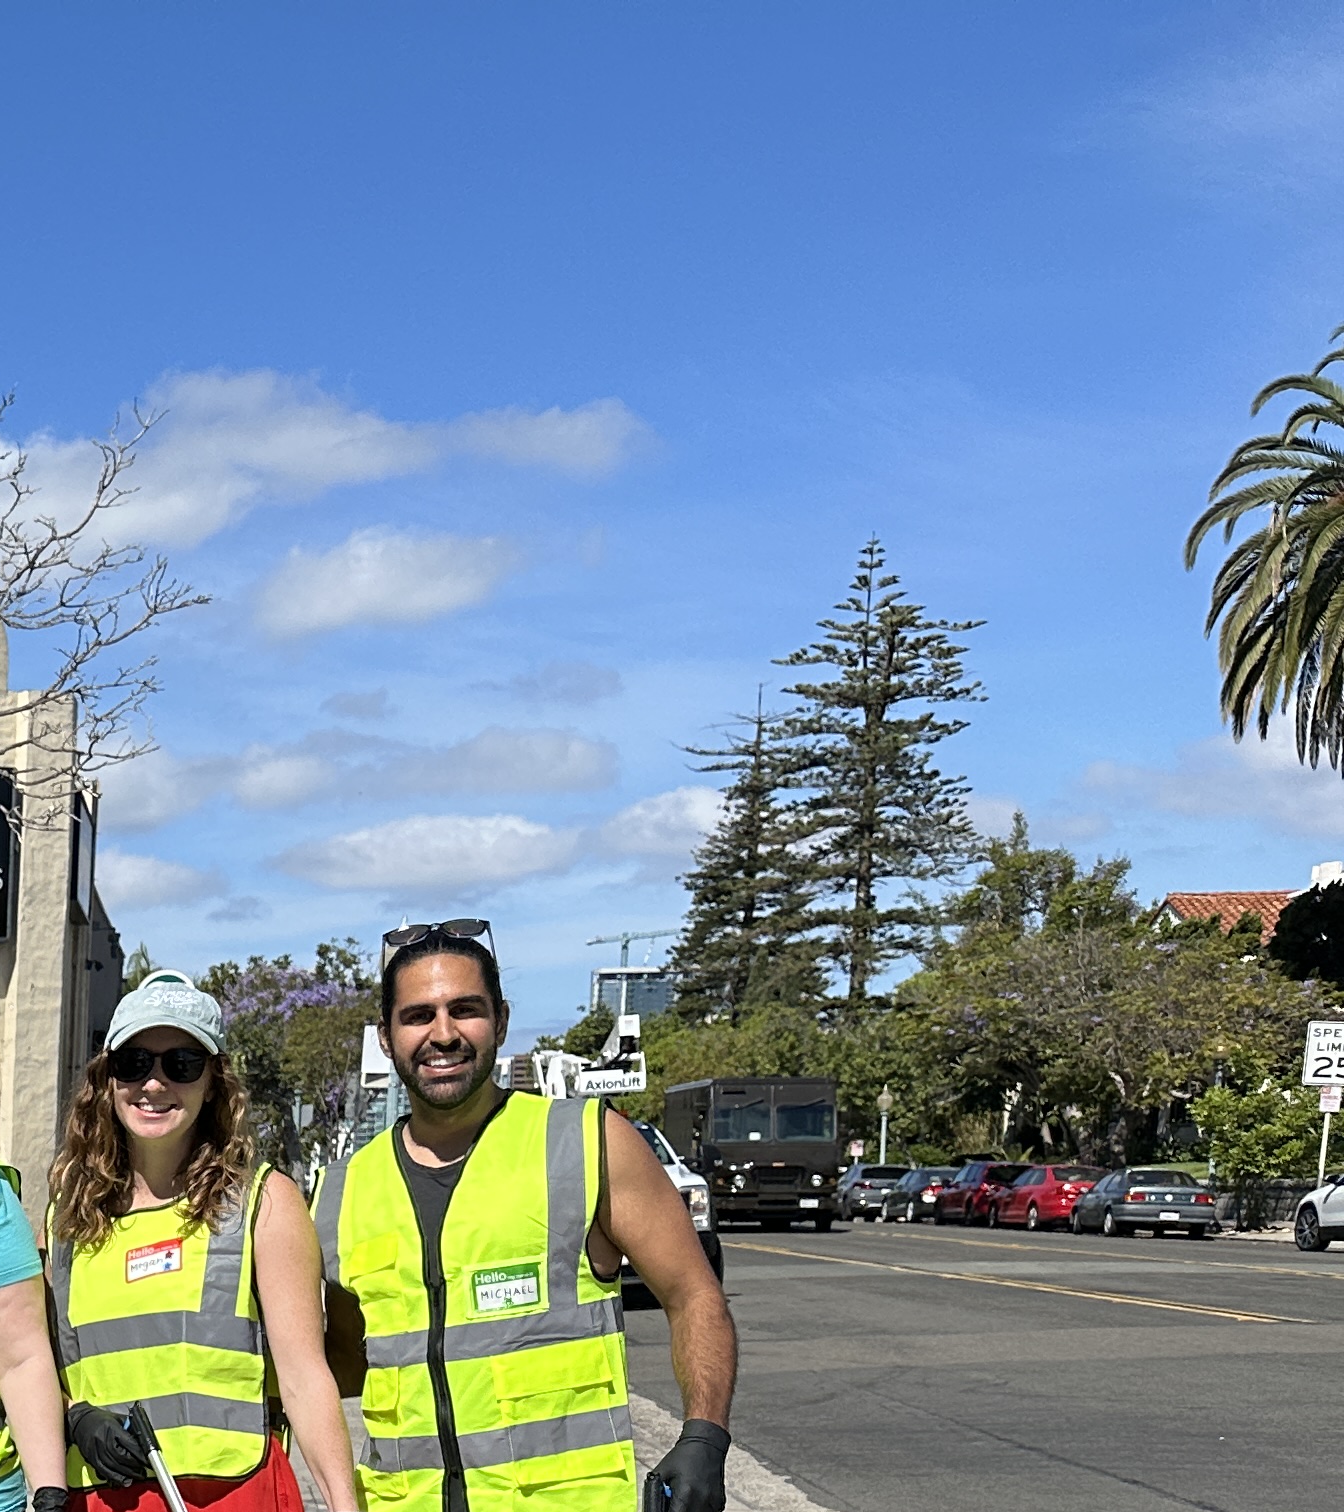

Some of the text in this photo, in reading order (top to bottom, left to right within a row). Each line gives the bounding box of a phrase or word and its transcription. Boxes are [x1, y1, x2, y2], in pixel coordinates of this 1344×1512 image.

[585, 1076, 641, 1090] AxionLift
[128, 1246, 155, 1260] Hello
[474, 1271, 507, 1284] Hello
[480, 1284, 535, 1302] MICHAEL
